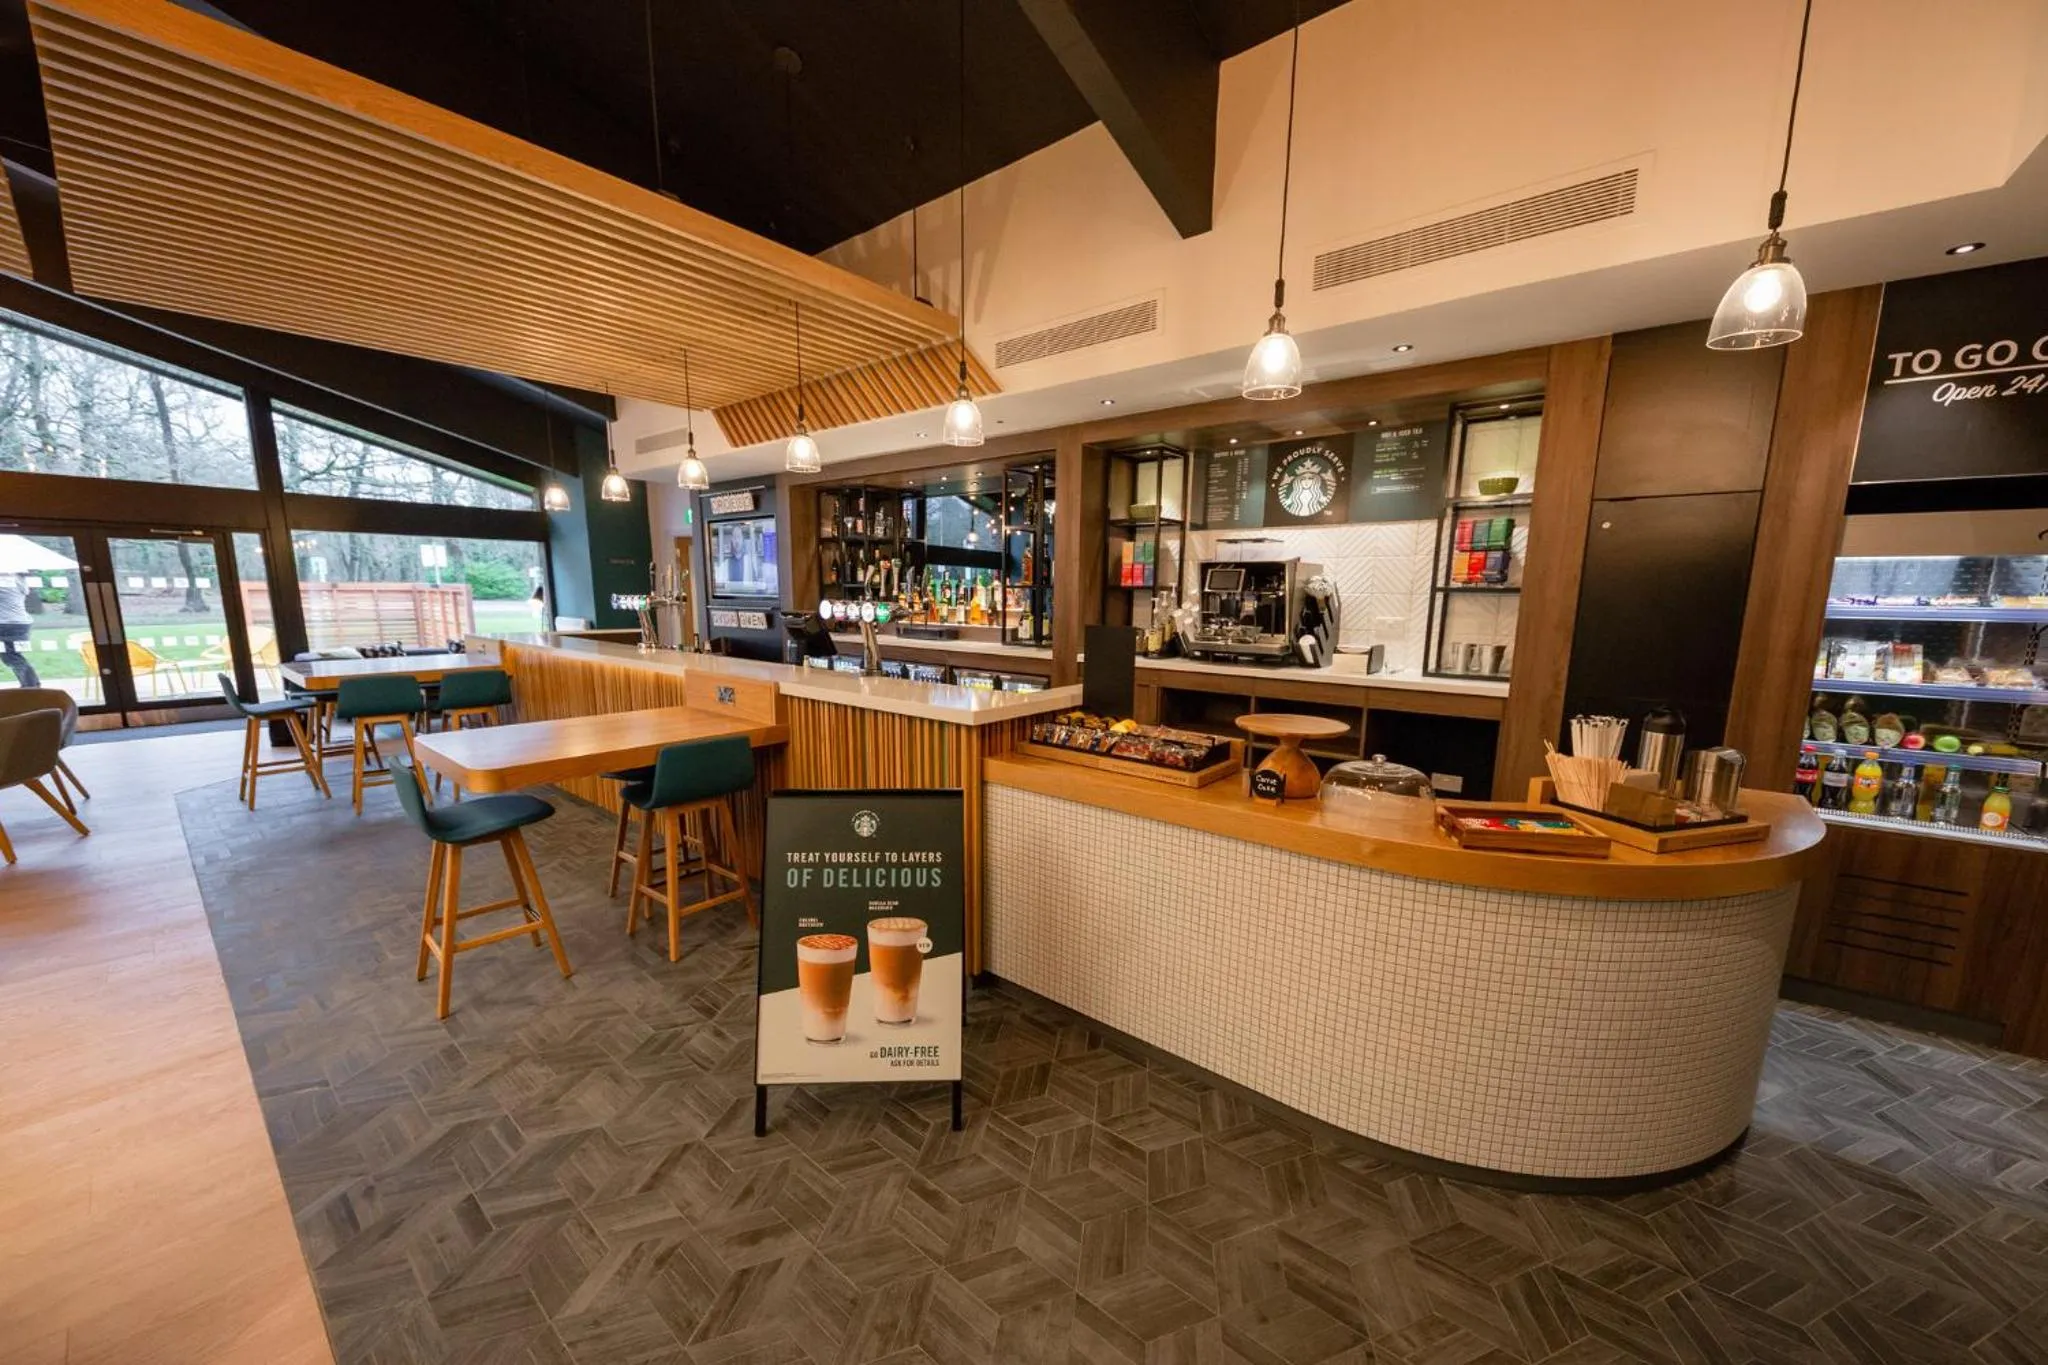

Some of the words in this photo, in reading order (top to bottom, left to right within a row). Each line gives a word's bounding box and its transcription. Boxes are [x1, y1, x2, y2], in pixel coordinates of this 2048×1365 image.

[1888, 348, 1942, 377] TO
[1954, 339, 2018, 370] GO
[1932, 382, 1997, 407] Open
[1282, 447, 1323, 466] PROUDLY
[787, 852, 820, 863] TREAT
[824, 852, 881, 863] YOURSELF
[885, 852, 898, 863] TO
[901, 852, 943, 863] LAYERS
[787, 868, 813, 888] OF
[823, 867, 942, 888] DELICIOUS
[880, 1046, 940, 1059] DAIRY-FREE
